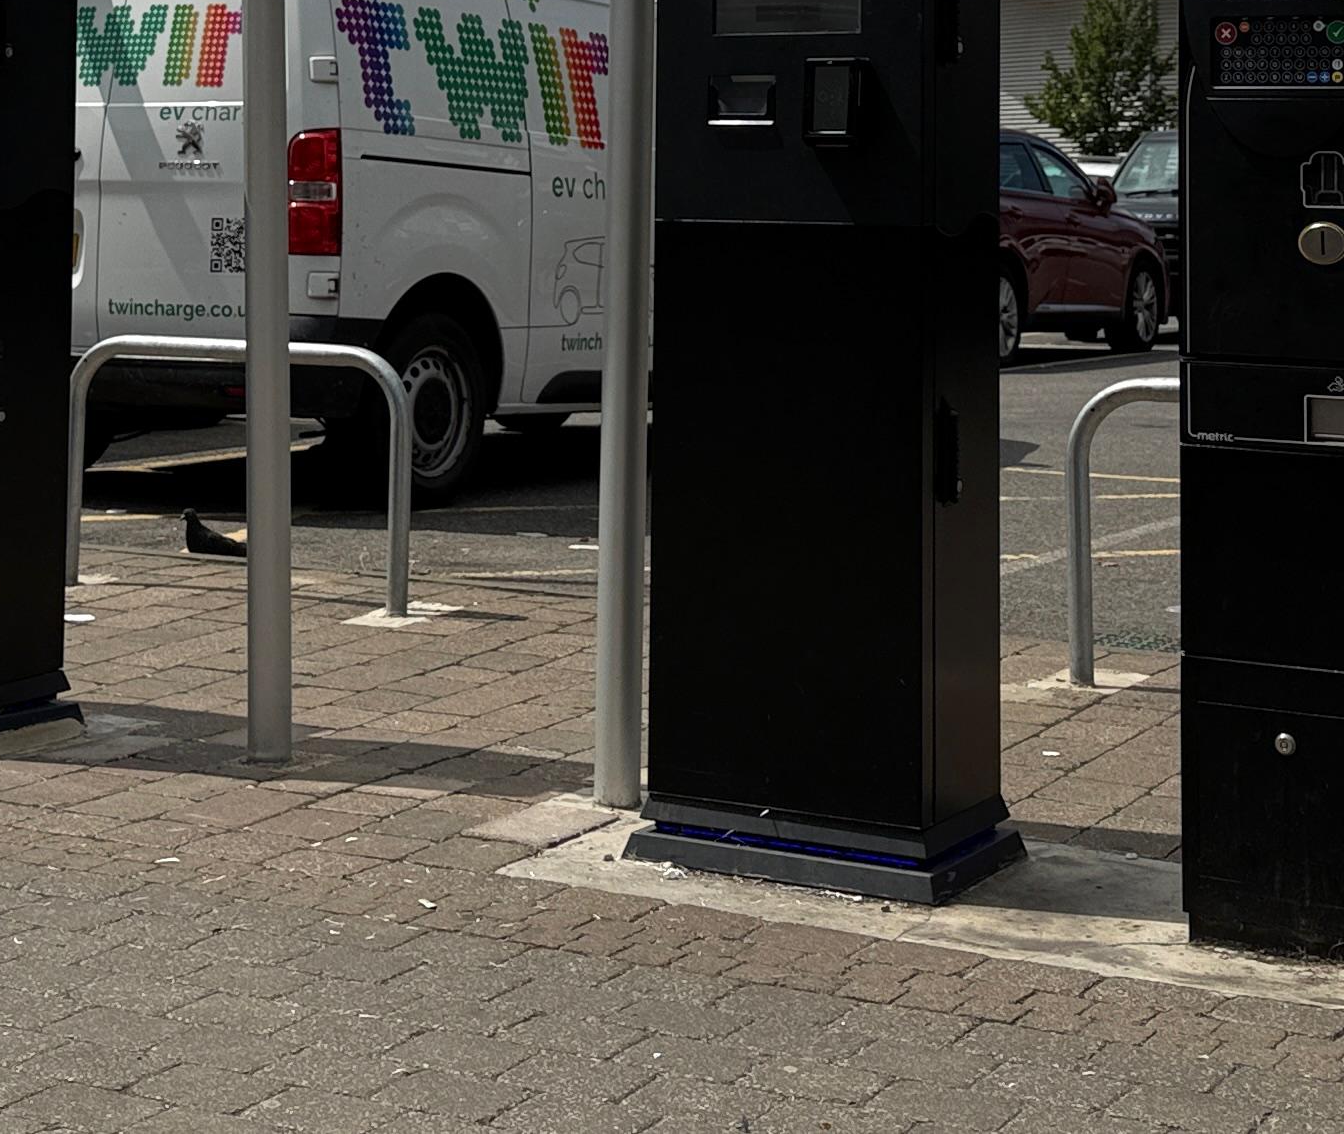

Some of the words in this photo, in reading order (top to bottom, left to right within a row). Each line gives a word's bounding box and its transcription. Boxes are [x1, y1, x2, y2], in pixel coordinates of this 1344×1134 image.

[160, 105, 185, 120] ev
[552, 176, 576, 198] ev
[1197, 431, 1234, 443] metric
